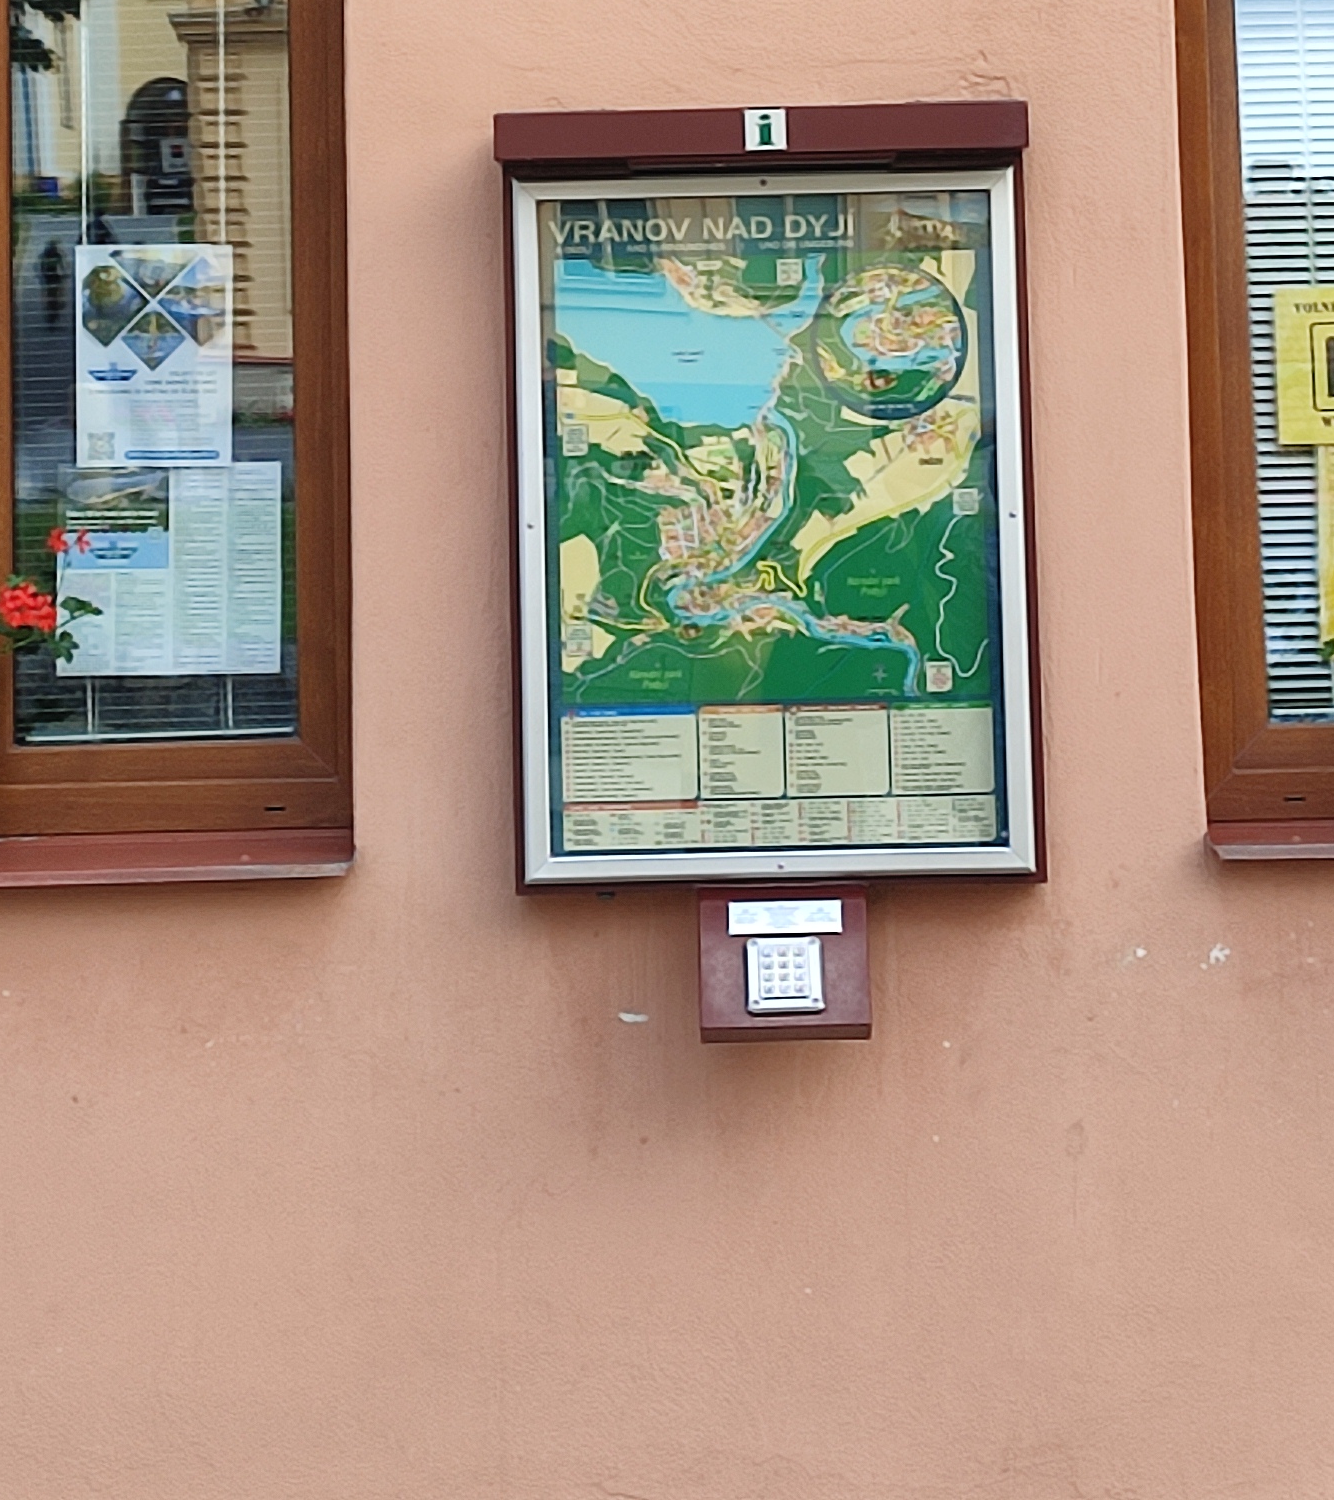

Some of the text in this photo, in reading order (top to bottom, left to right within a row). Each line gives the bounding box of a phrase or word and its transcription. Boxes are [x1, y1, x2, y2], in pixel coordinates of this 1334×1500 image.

[547, 208, 855, 244] VRANOV NAD DYJÍ
